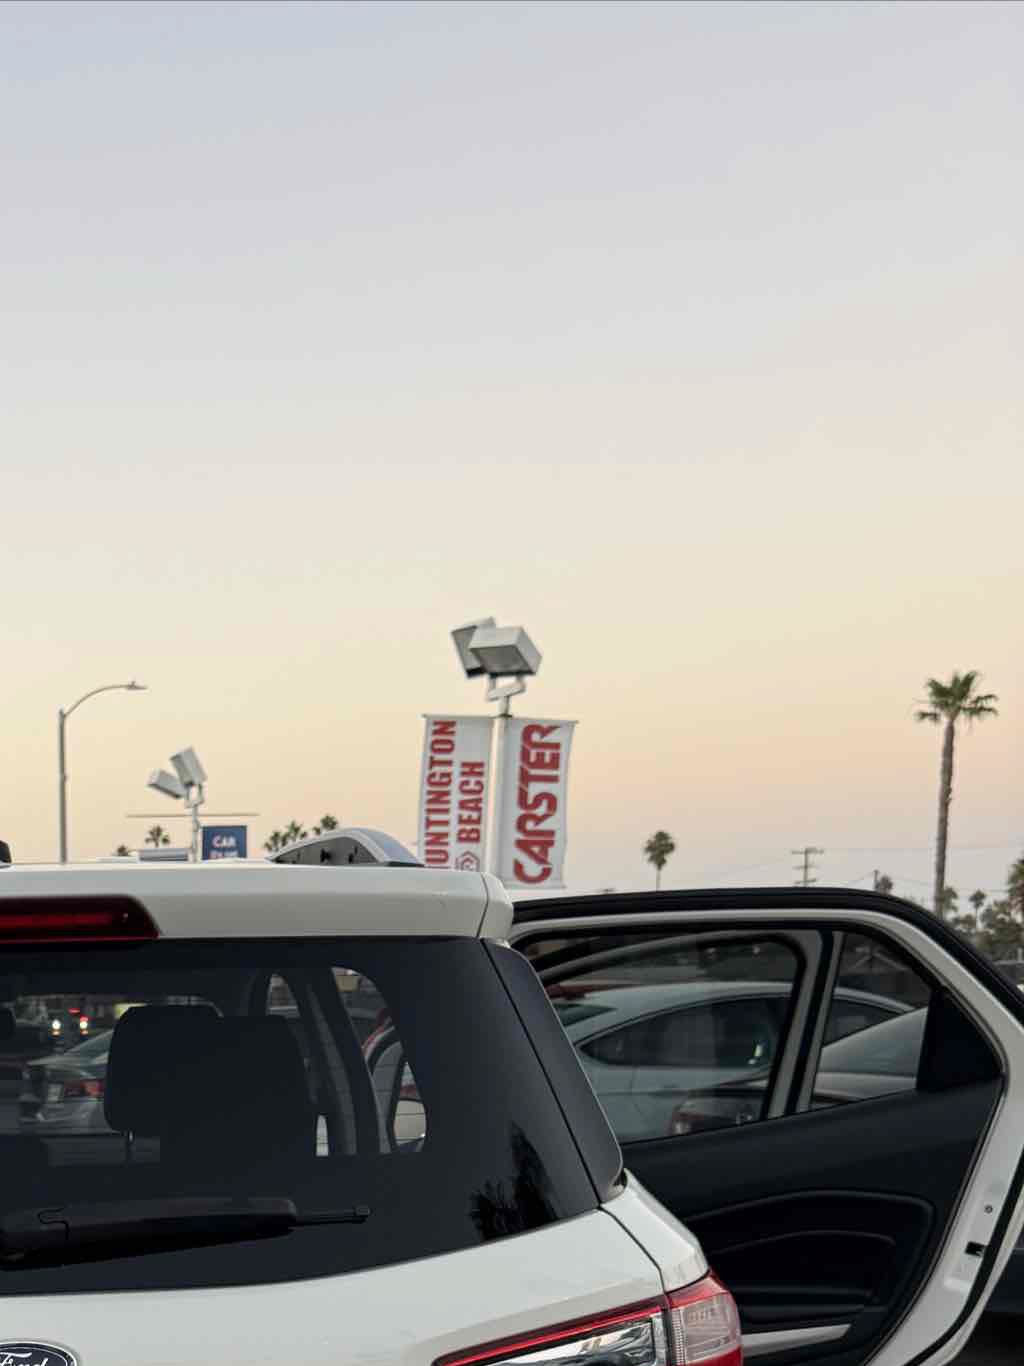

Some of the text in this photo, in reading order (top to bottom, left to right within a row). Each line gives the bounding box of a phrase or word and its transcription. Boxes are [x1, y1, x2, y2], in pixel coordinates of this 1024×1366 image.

[424, 720, 457, 868] UNTINGTON
[457, 761, 485, 844] BEACH
[513, 723, 562, 885] CARSTER
